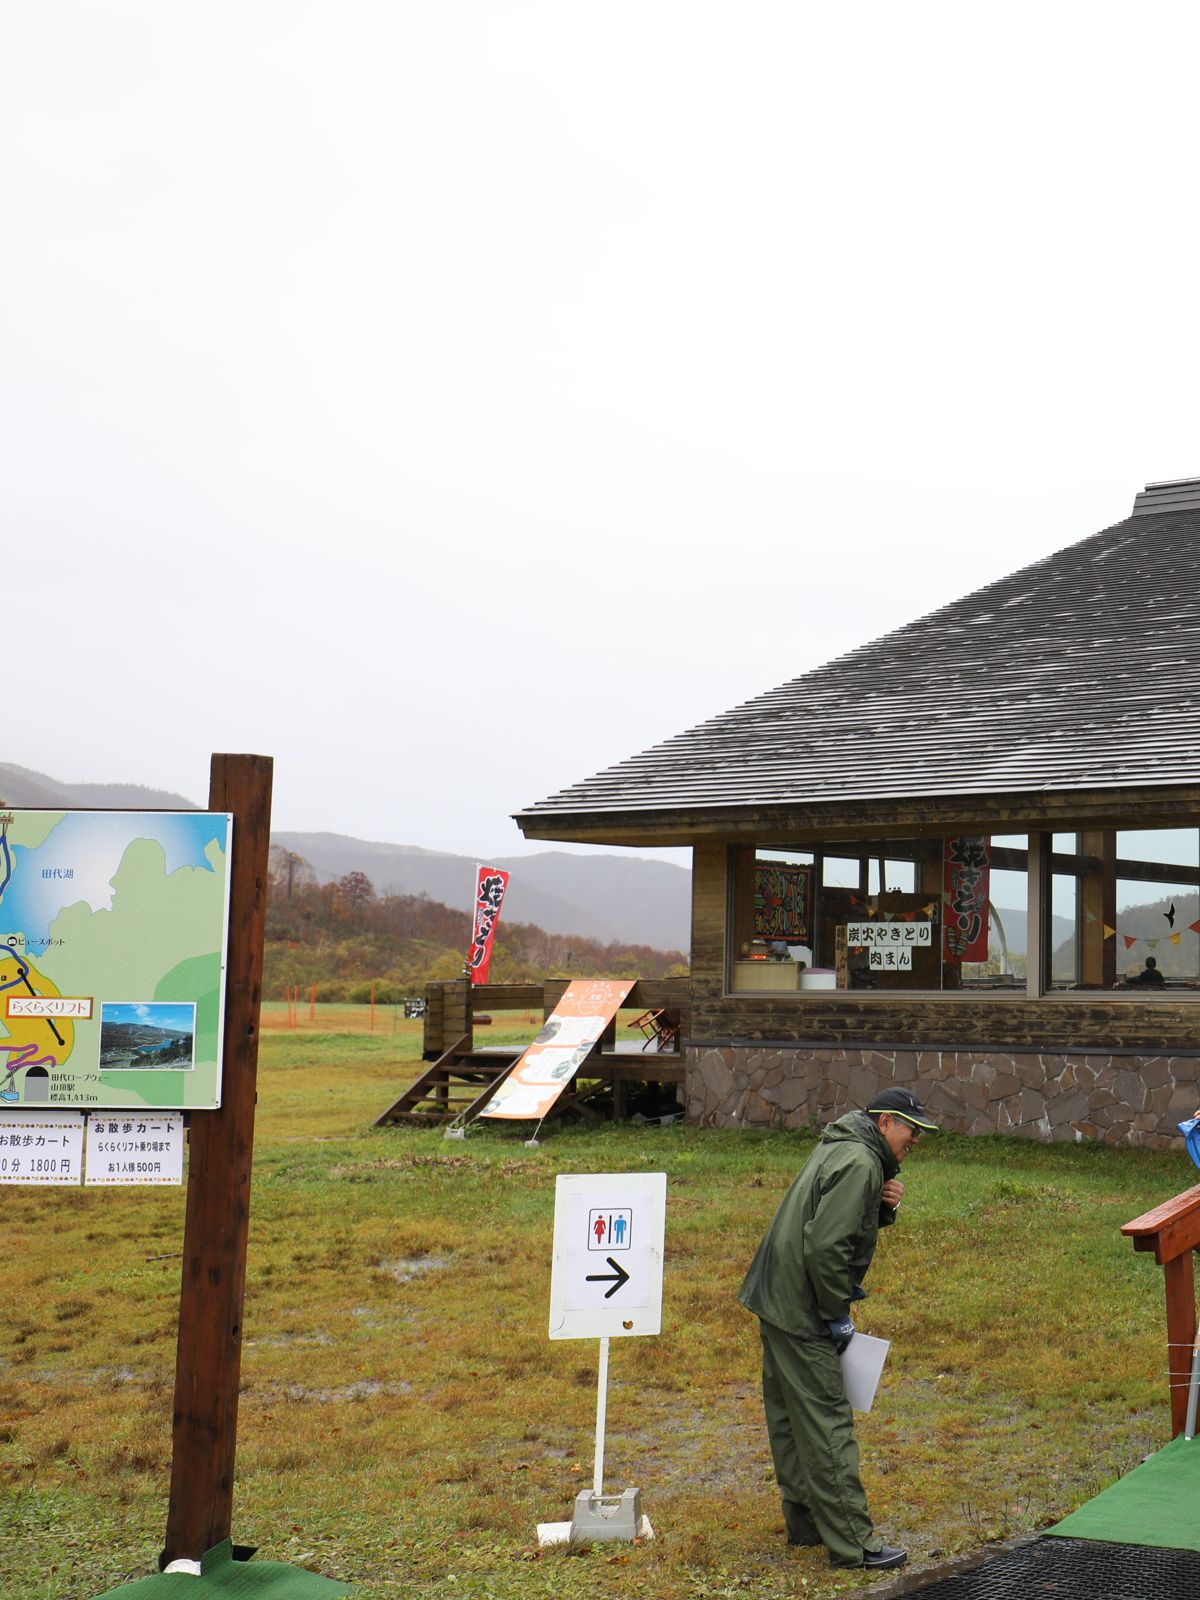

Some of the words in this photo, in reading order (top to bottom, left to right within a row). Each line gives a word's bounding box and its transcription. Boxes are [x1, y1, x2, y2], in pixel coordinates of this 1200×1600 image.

[41, 868, 75, 880] 田代湖
[848, 926, 930, 942] 炭火やきとり
[870, 951, 910, 965] 肉まん
[12, 1001, 87, 1014] らくらくリフト
[95, 1122, 175, 1134] お散歩カート
[0, 1135, 70, 1147] お散歩カート
[98, 1142, 171, 1152] らくらくリフト乗り場まで
